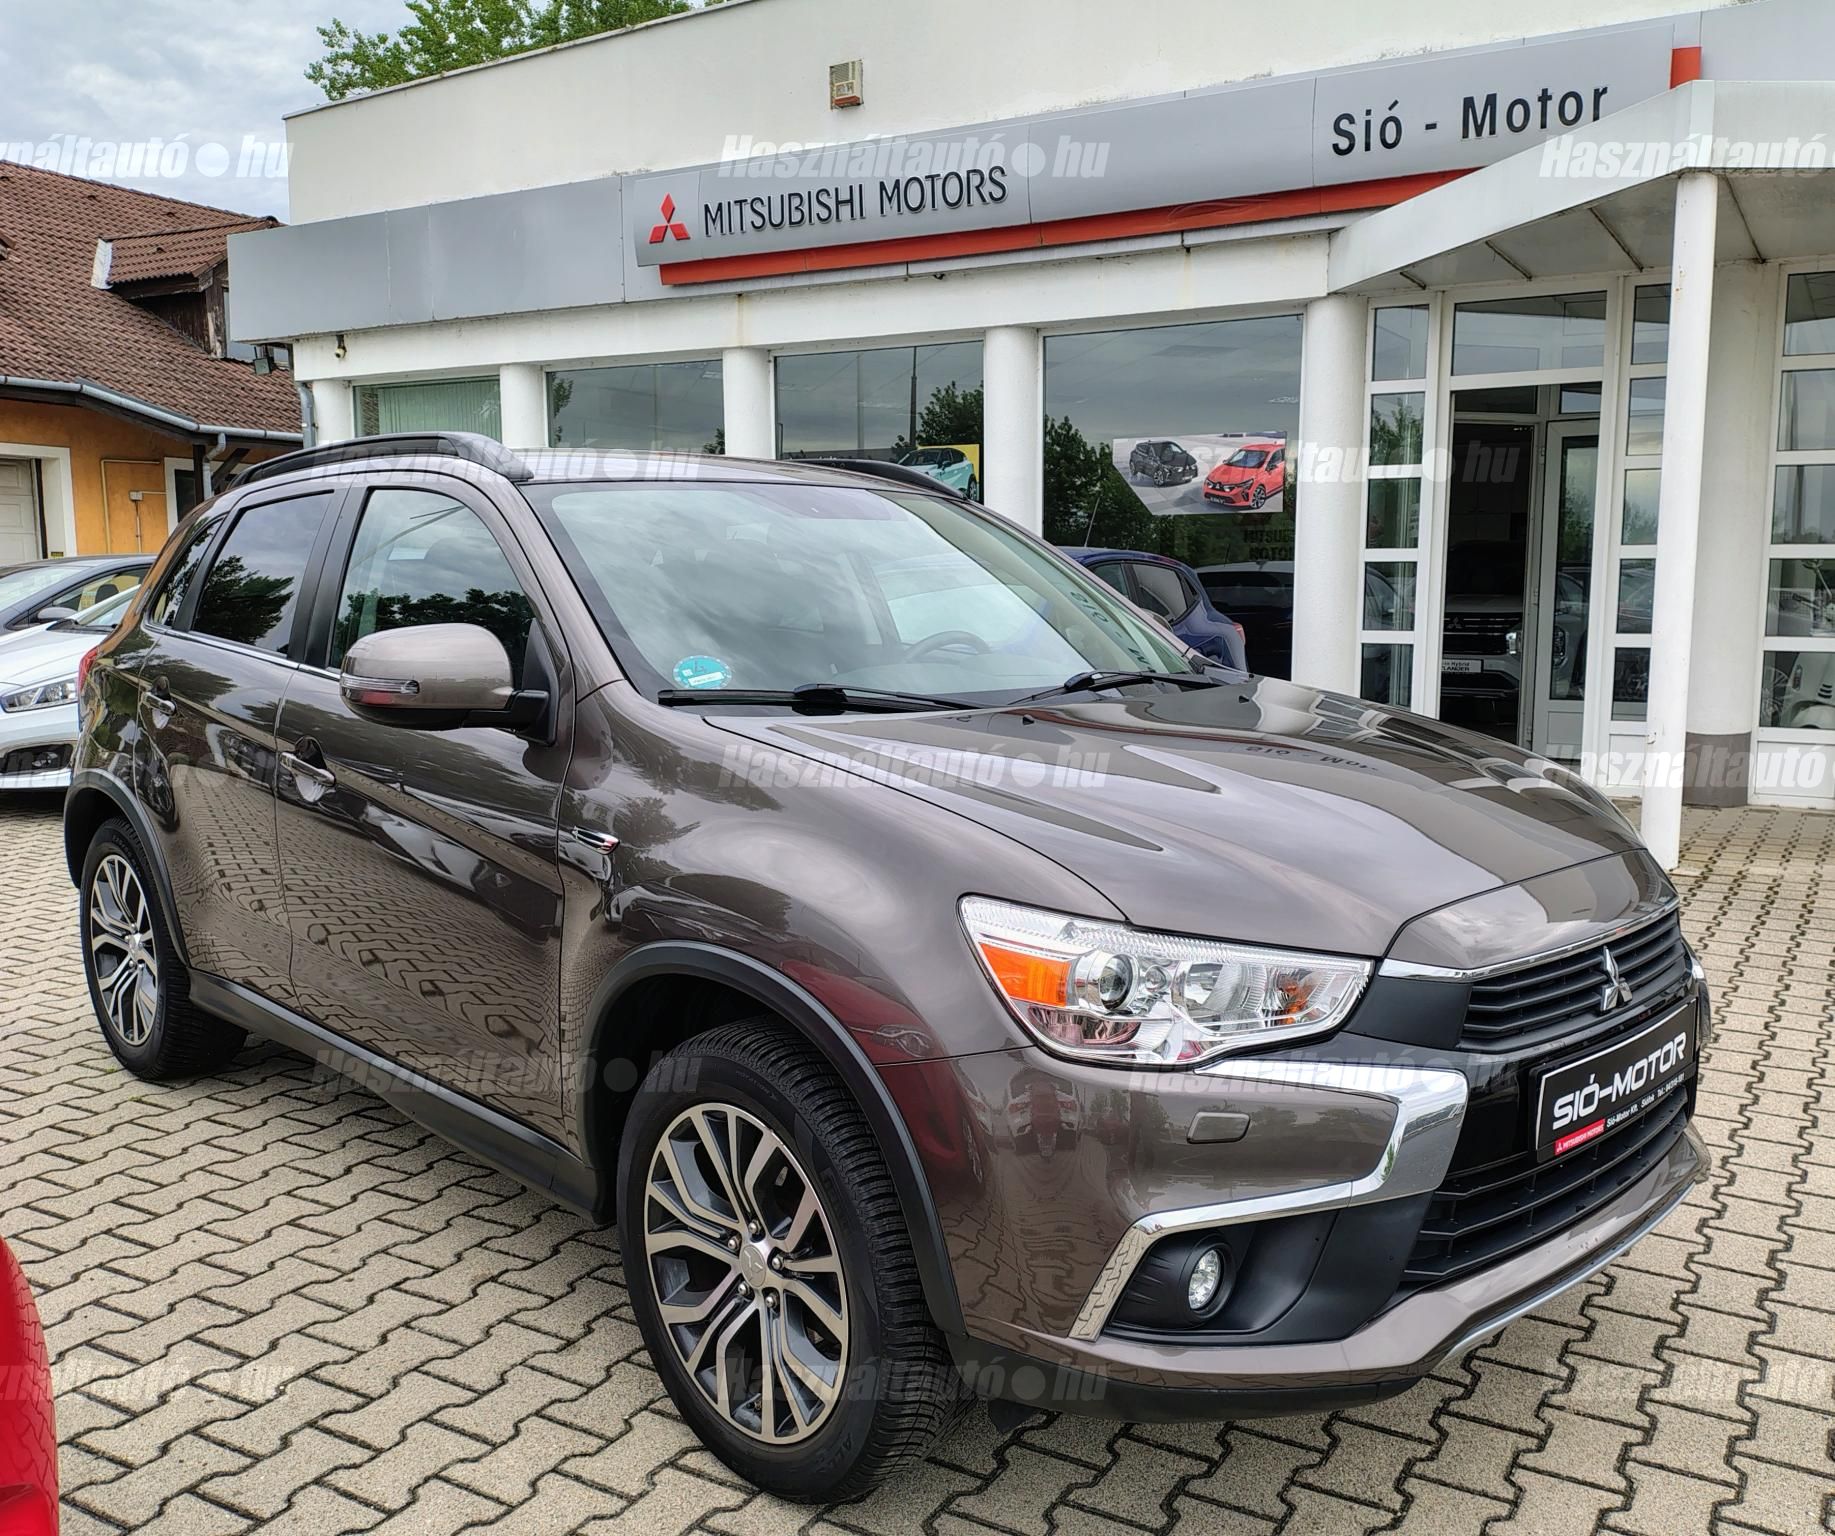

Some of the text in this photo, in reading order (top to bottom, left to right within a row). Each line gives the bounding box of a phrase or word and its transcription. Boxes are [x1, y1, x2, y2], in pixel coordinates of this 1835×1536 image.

[1332, 86, 1608, 156] Sió - Motor
[703, 165, 1008, 237] MITSUBISHI MOTORS
[1552, 1031, 1687, 1131] SIÓ-MOTOR
